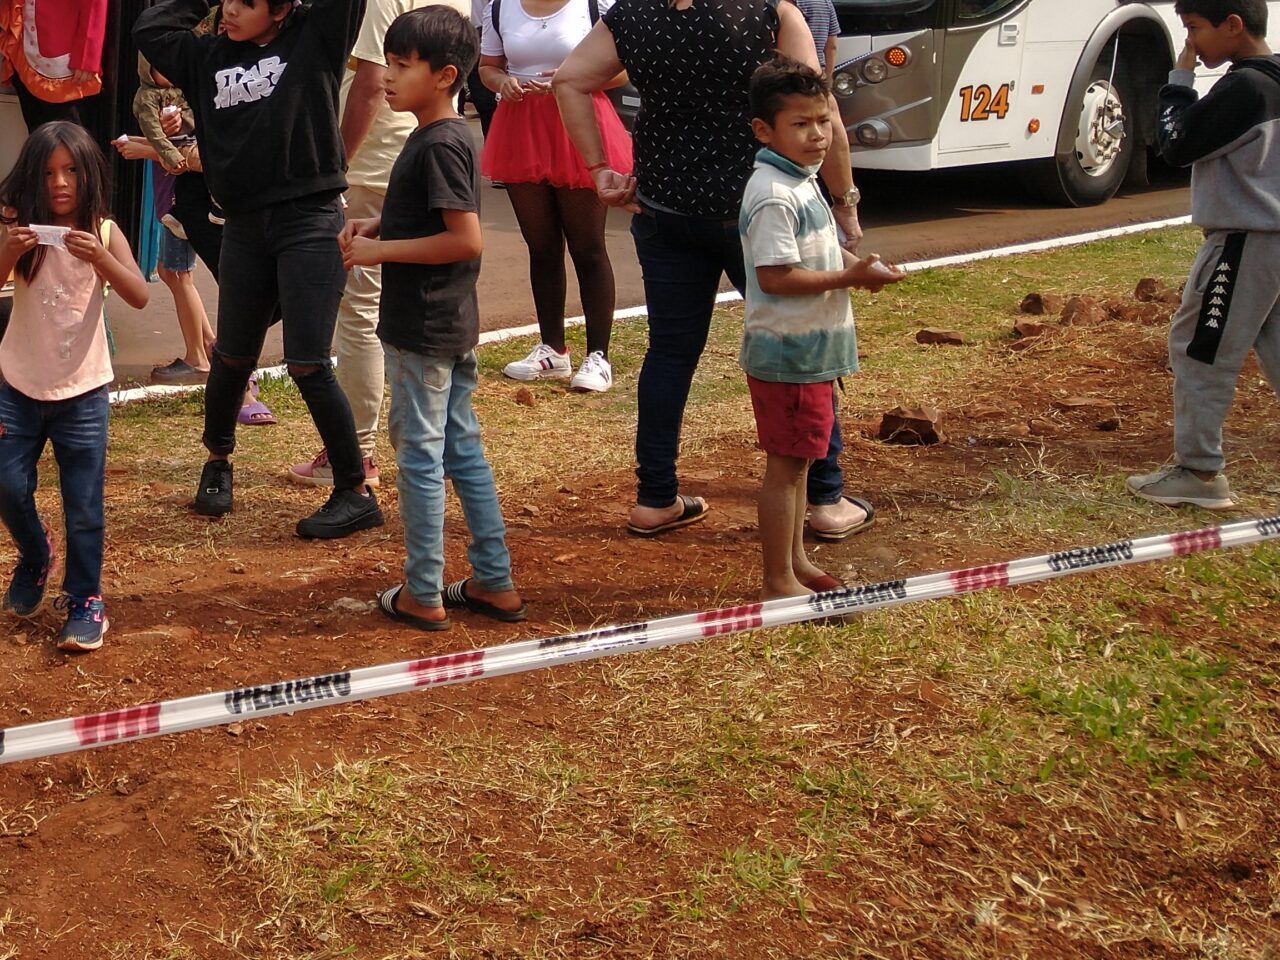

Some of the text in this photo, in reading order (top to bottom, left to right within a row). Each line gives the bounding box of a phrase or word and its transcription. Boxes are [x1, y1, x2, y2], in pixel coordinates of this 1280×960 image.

[215, 55, 288, 87] STAR
[213, 78, 276, 110] WARS
[959, 83, 1010, 122] 124
